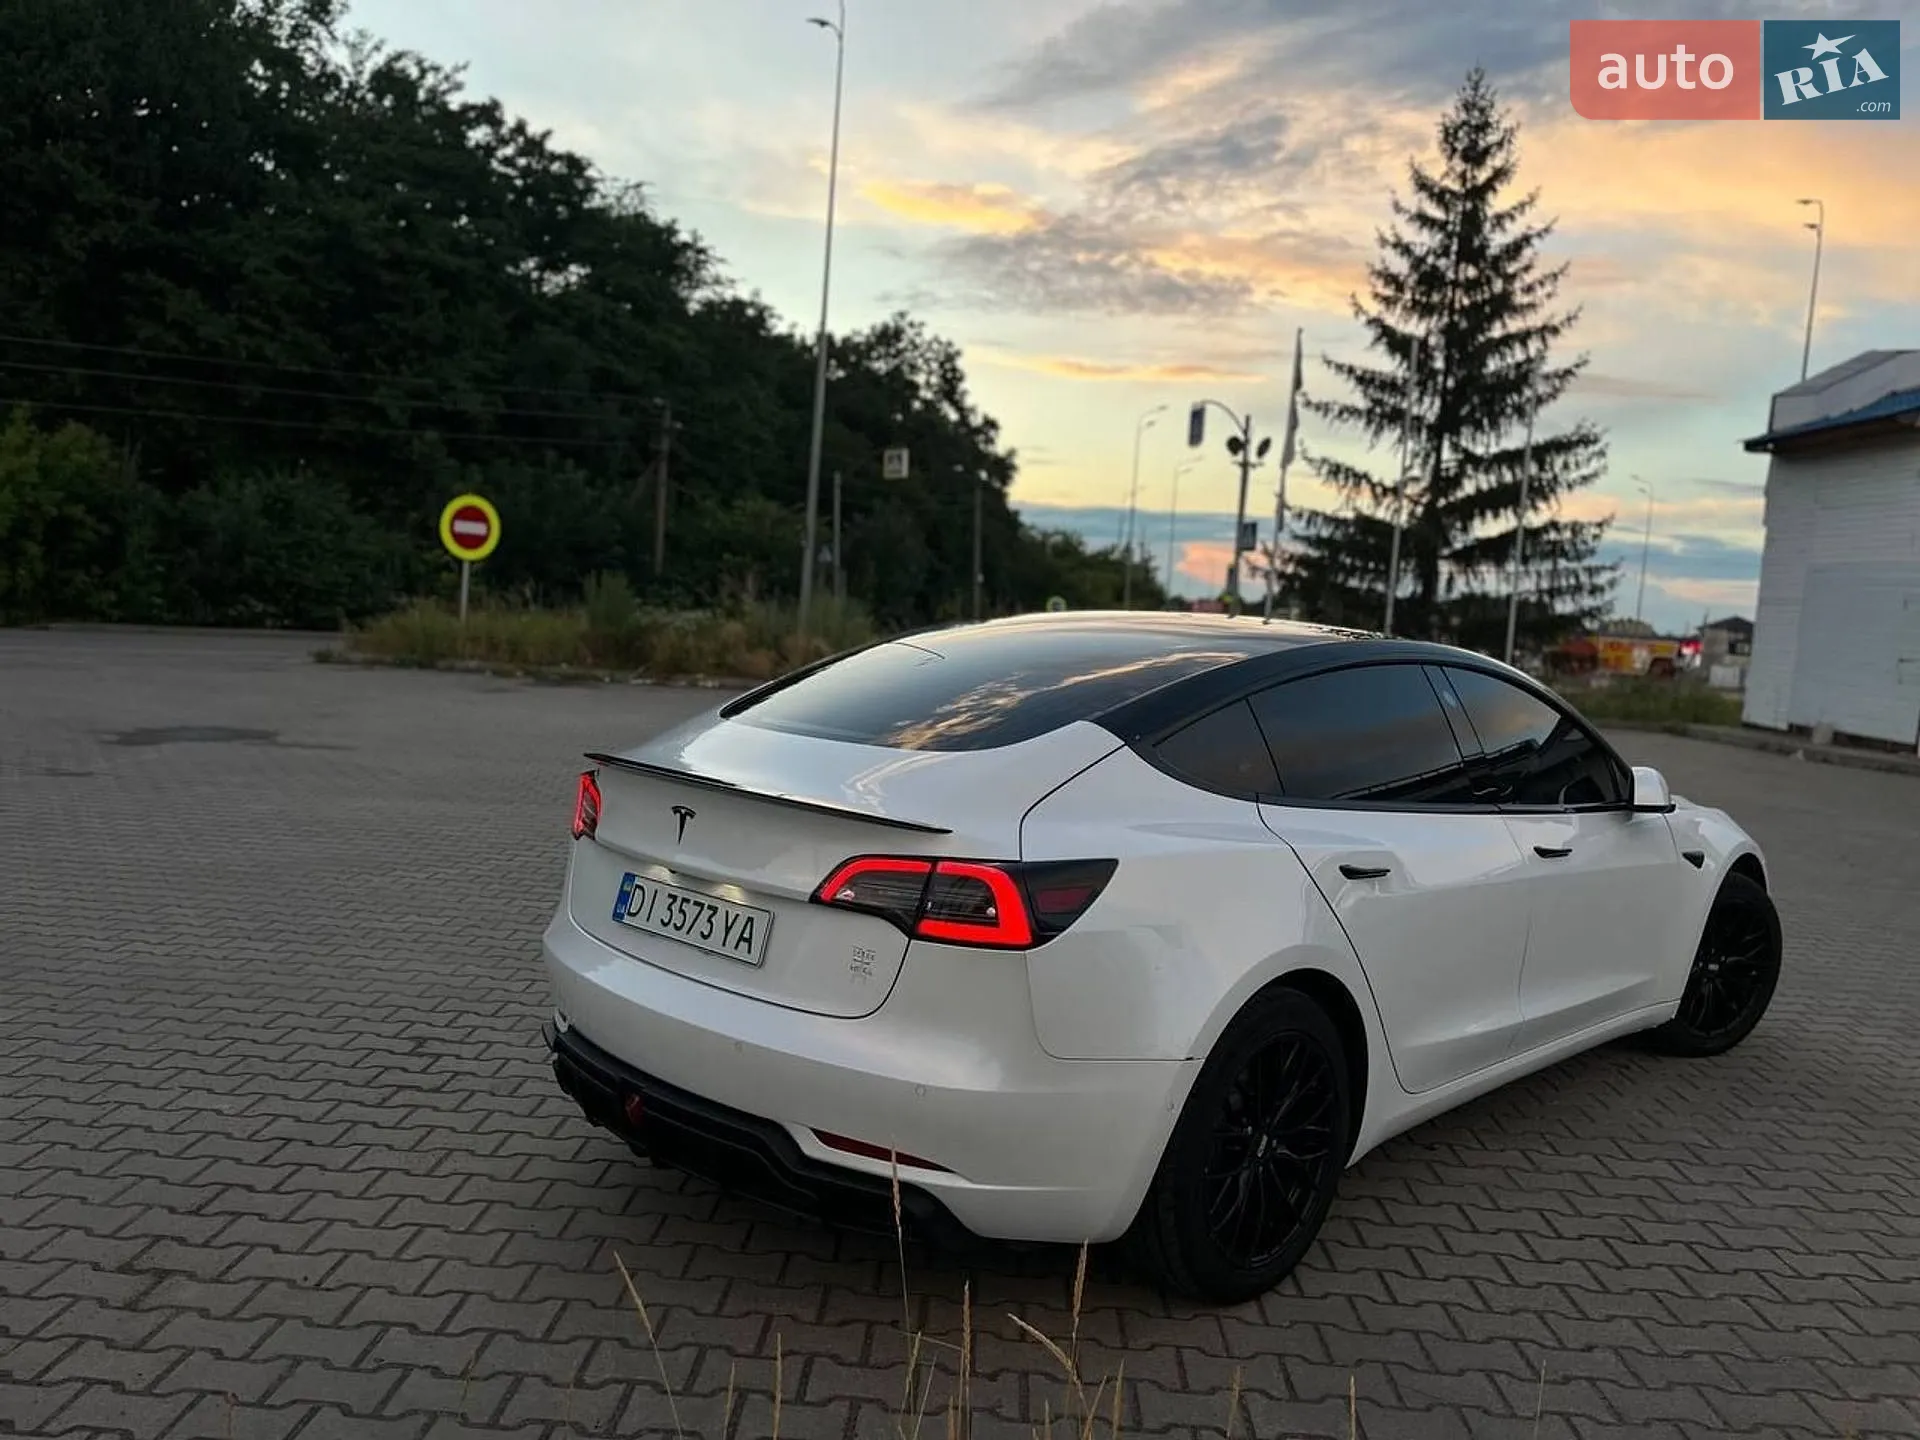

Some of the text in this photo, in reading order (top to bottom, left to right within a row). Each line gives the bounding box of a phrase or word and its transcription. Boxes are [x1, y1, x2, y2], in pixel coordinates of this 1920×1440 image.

[627, 884, 755, 954] DI 3573 YA
